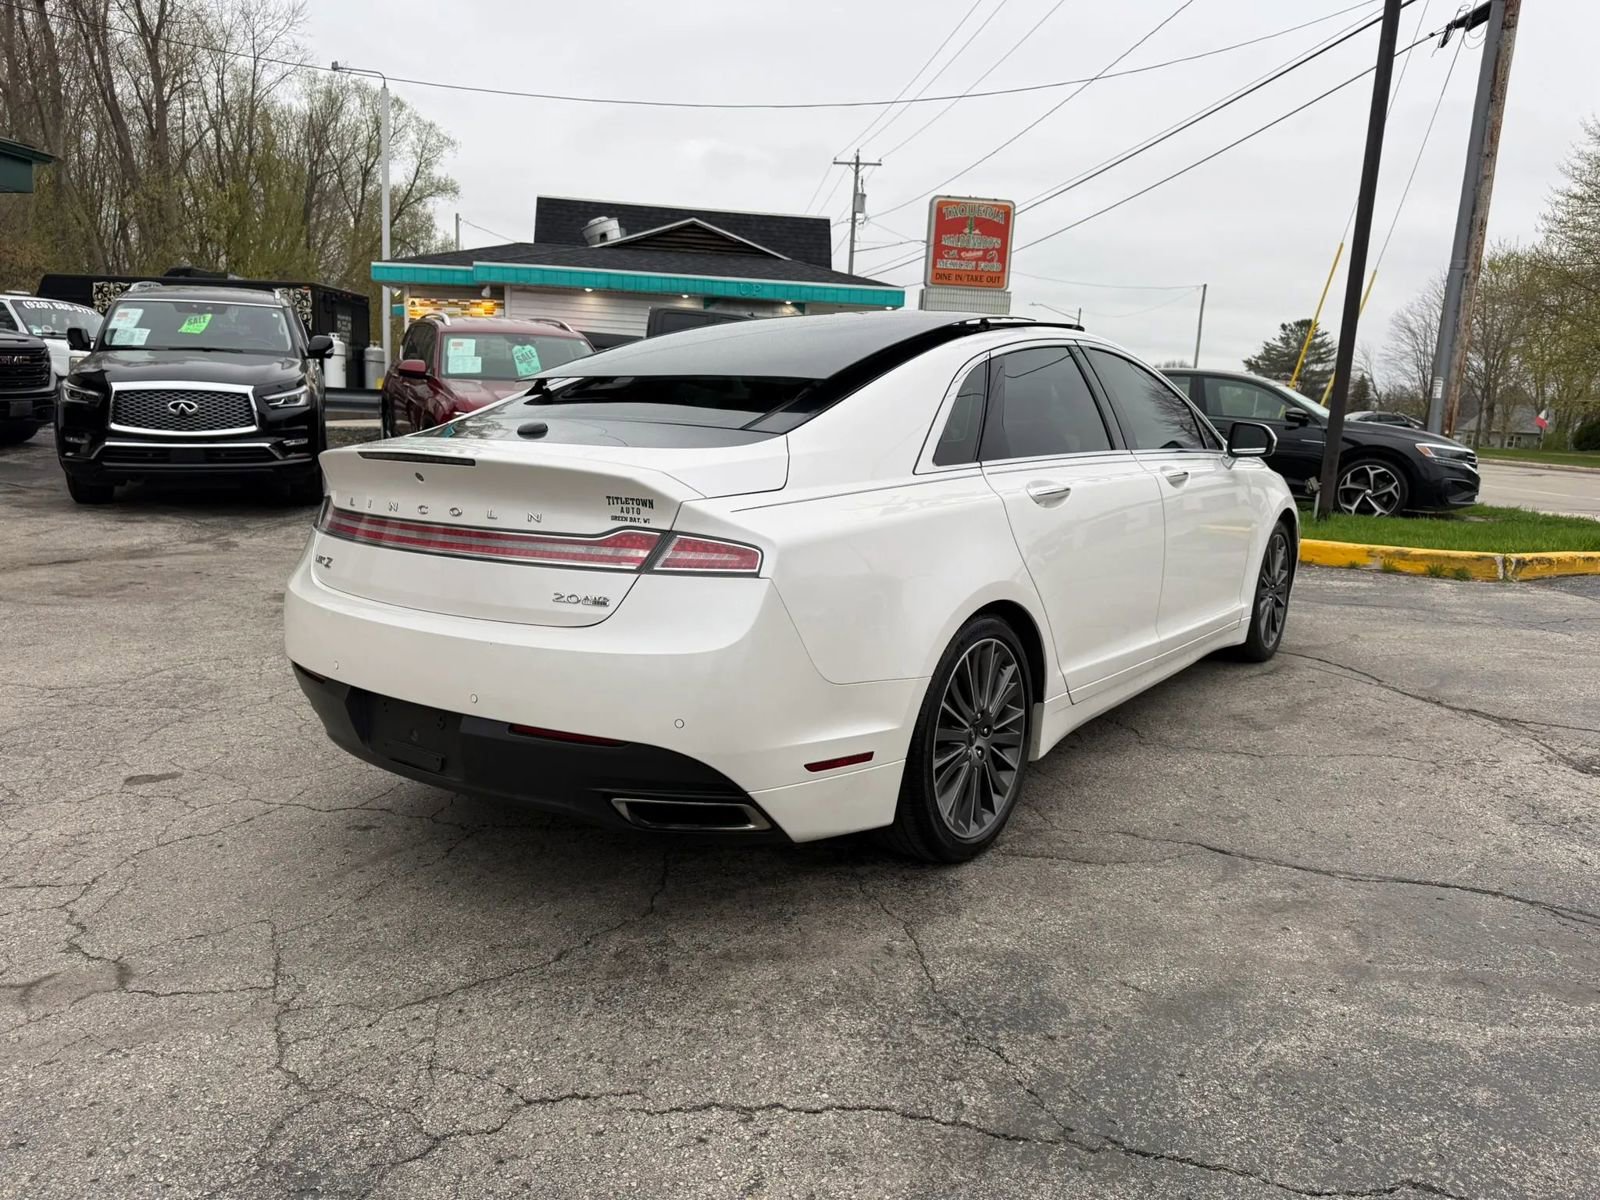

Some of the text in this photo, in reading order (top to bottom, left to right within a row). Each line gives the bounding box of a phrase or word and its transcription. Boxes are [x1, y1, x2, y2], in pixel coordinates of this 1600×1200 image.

[935, 272, 952, 281] DINE
[985, 275, 1001, 284] OUT
[187, 314, 207, 326] SALE
[515, 349, 536, 364] SALE
[605, 495, 654, 509] TITLETOWN
[349, 497, 543, 524] LINCOLN
[620, 506, 641, 515] AUTO
